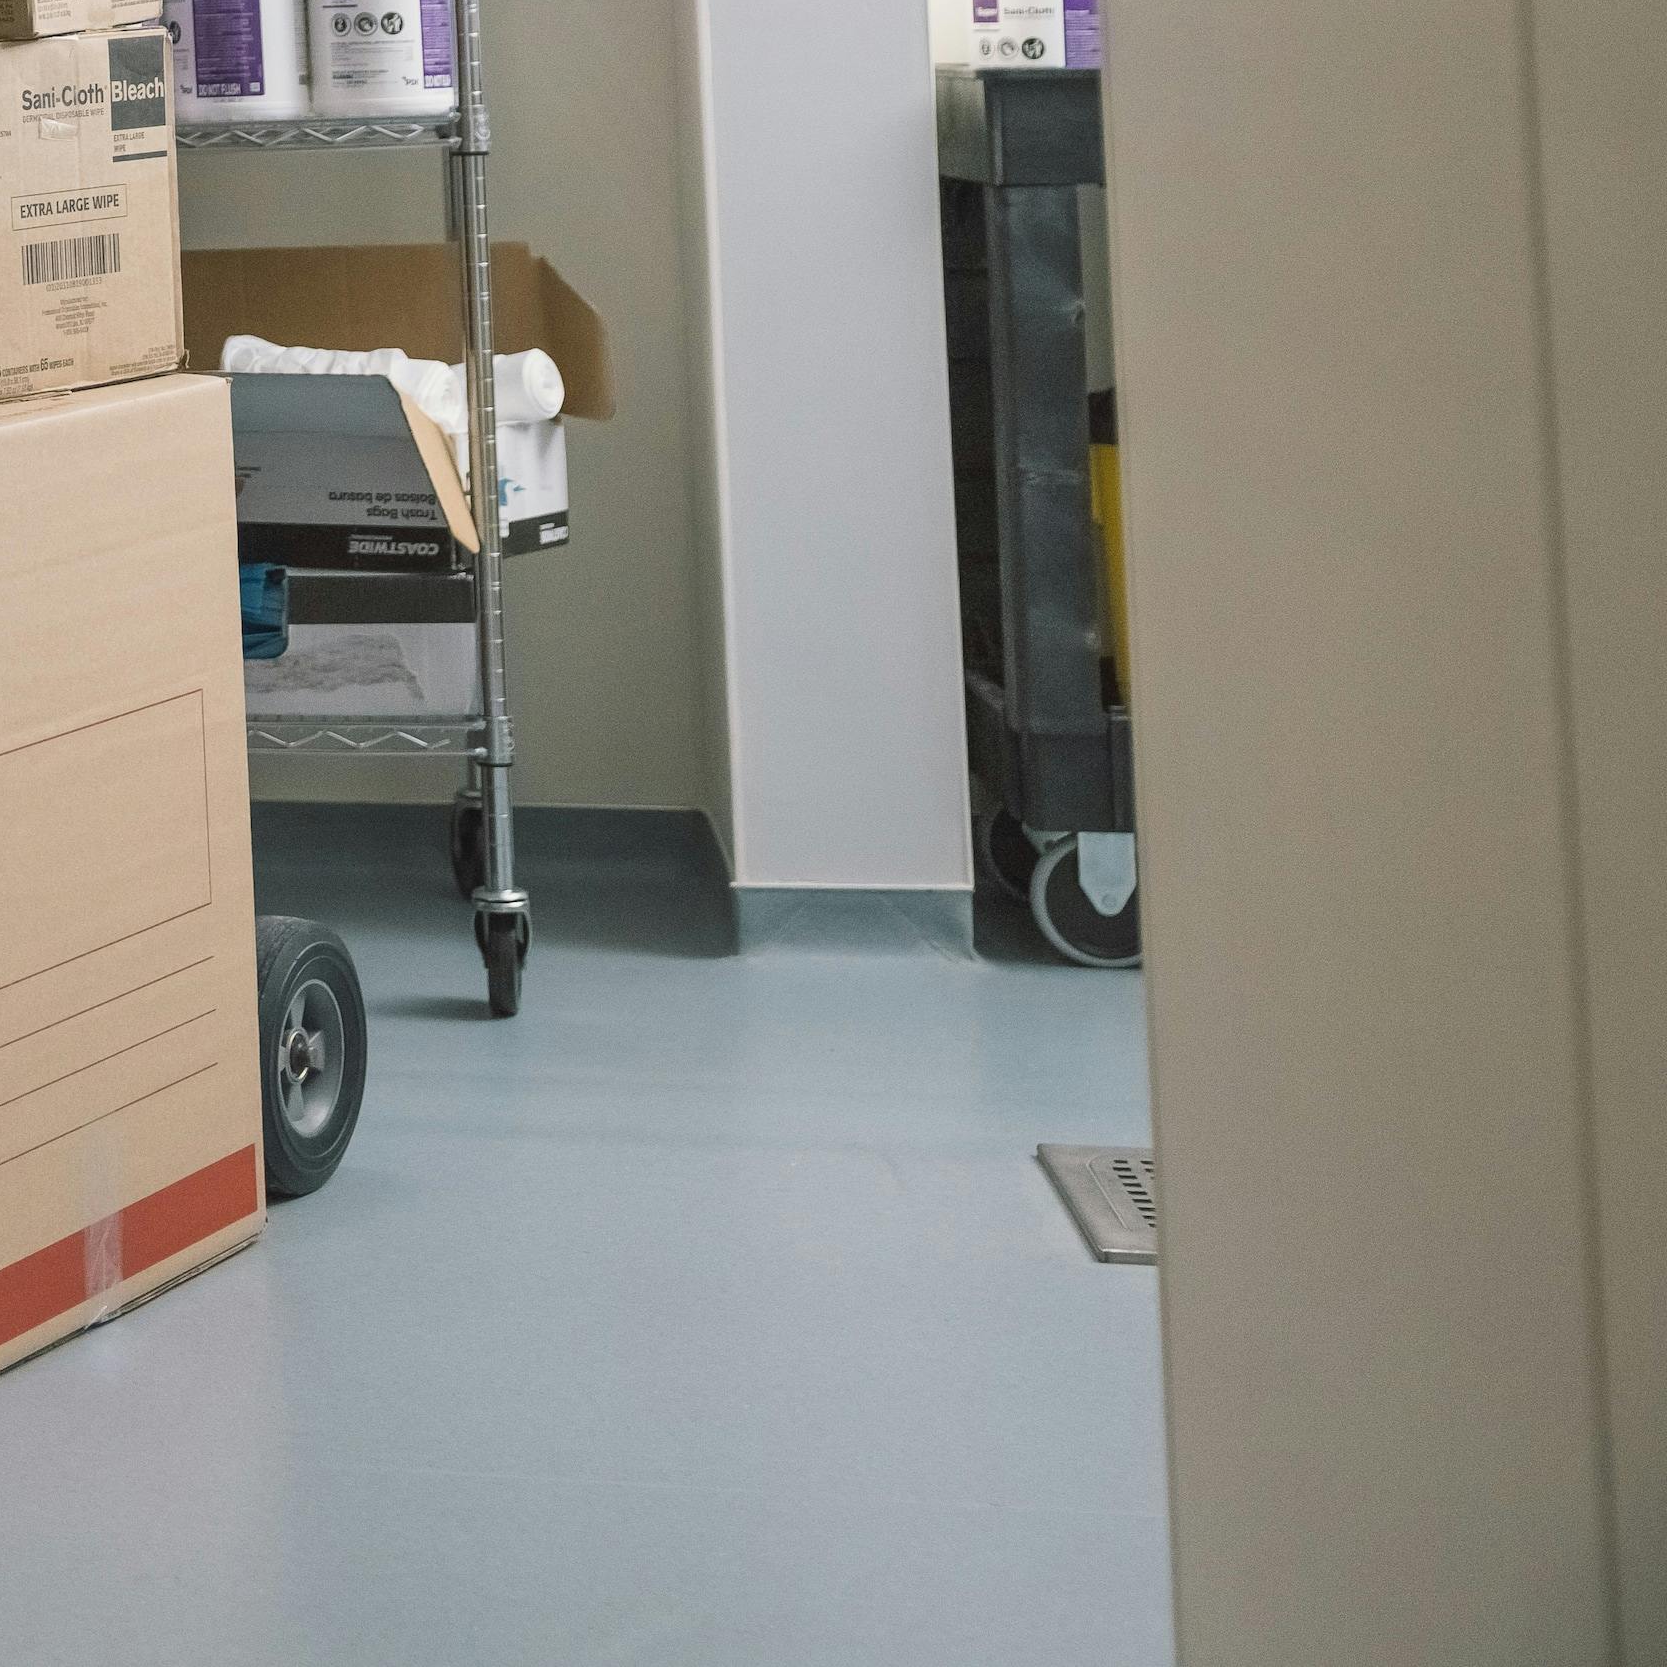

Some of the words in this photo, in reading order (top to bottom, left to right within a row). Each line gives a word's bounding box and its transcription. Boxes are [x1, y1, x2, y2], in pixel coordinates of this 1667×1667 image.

[22, 83, 105, 111] Sani-Cloth
[112, 77, 165, 102] Bleach
[91, 108, 105, 117] WIPE
[114, 133, 130, 143] EXTRA
[131, 131, 145, 141] LARGE
[114, 144, 126, 153] WIPE
[20, 204, 54, 219] EXTRA
[56, 198, 90, 214] LARGE
[93, 194, 120, 210] WIPE
[40, 357, 49, 372] 65
[328, 491, 373, 505] basura
[376, 493, 392, 505] de
[395, 493, 436, 505] Bolsas
[366, 506, 398, 520] Bags
[402, 507, 437, 521] Trash
[348, 540, 440, 555] COASTWIDE
